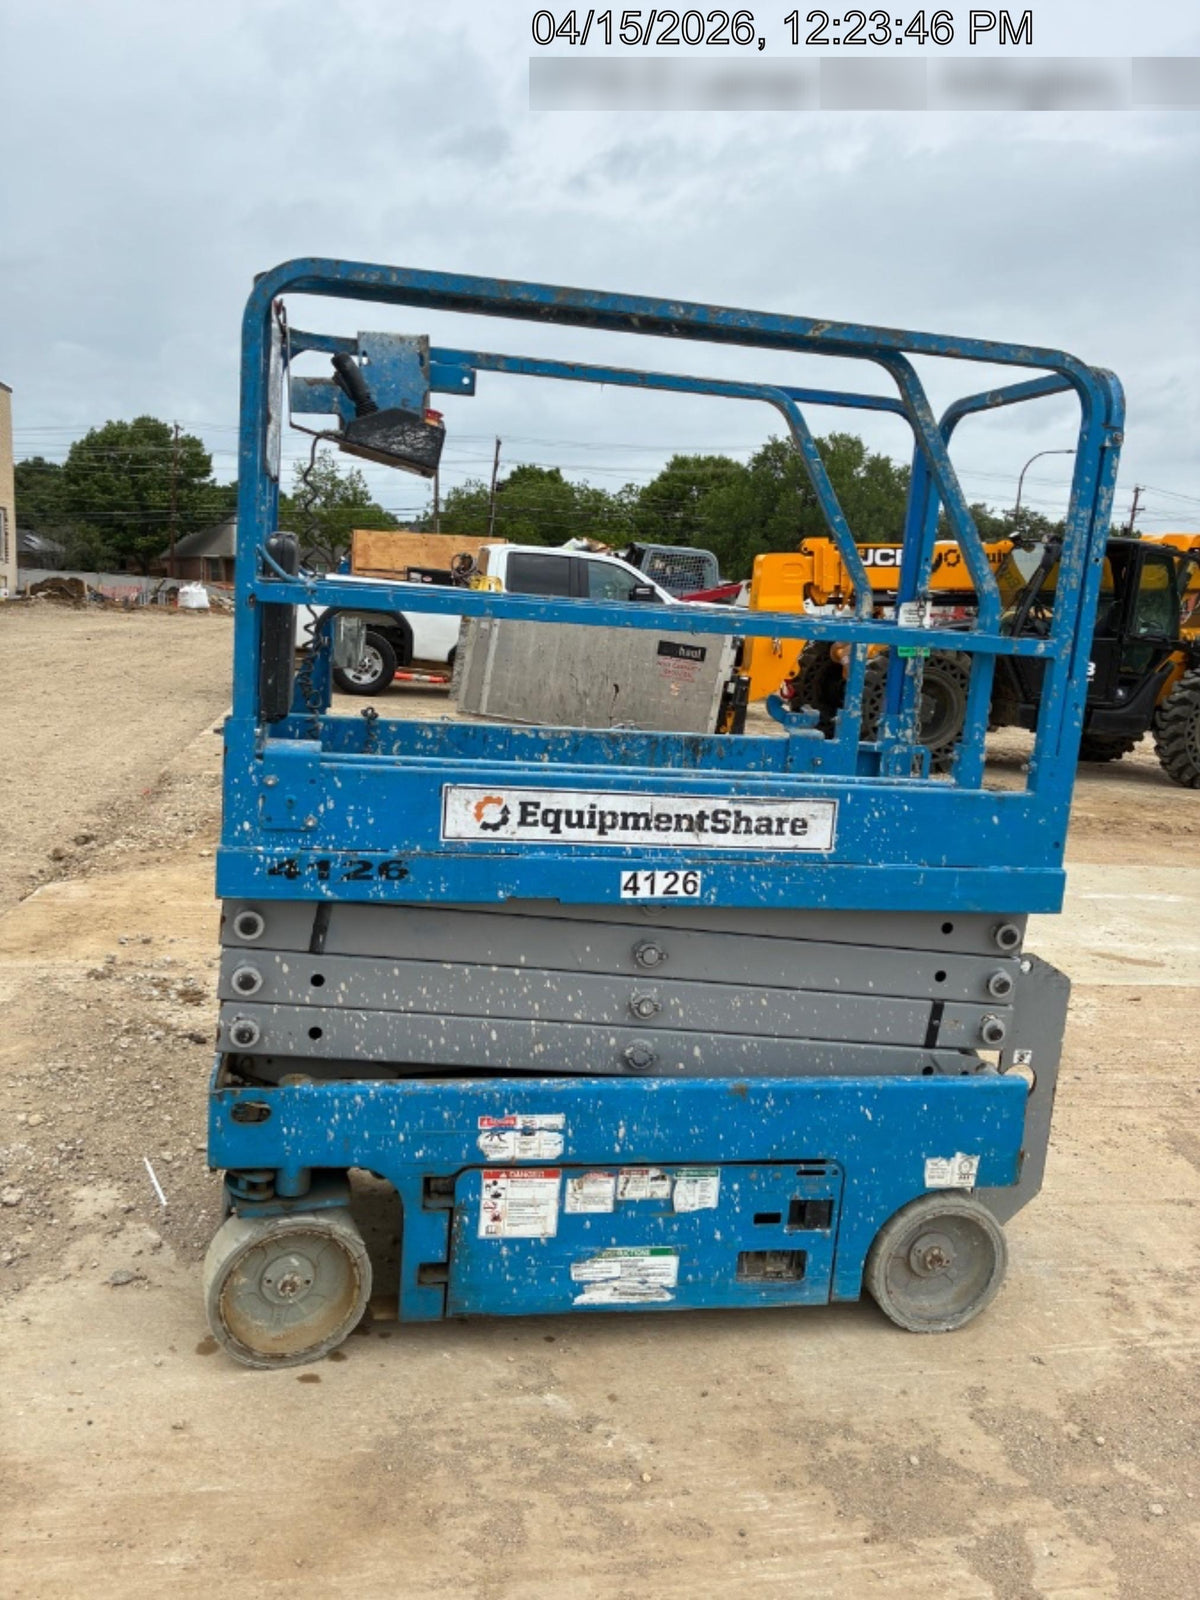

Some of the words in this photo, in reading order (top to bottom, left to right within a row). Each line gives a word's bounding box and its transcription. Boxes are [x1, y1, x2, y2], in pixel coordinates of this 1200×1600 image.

[517, 801, 809, 836] EquipmentShare
[267, 859, 409, 881] 4126
[623, 871, 698, 896] 4126
